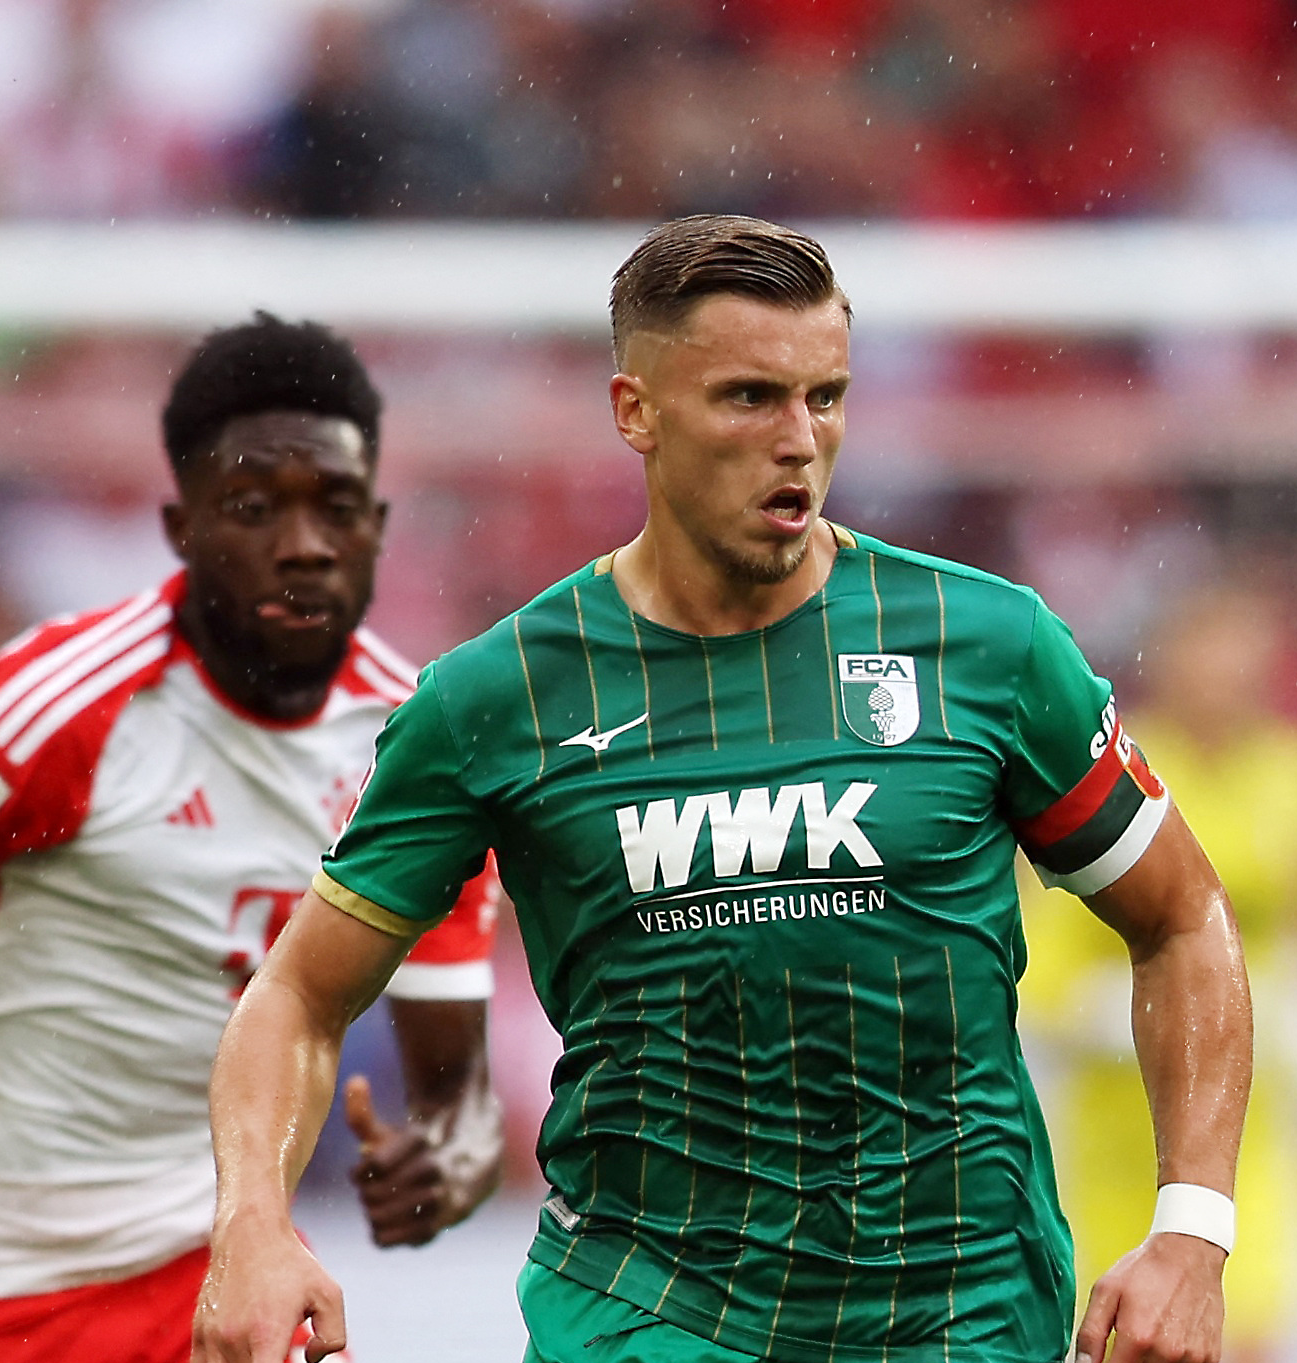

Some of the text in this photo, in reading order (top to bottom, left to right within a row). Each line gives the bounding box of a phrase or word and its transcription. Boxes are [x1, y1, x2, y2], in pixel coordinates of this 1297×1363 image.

[846, 659, 909, 678] FCA
[615, 781, 884, 893] WWK
[636, 889, 886, 933] VERSICHERUNGEN
